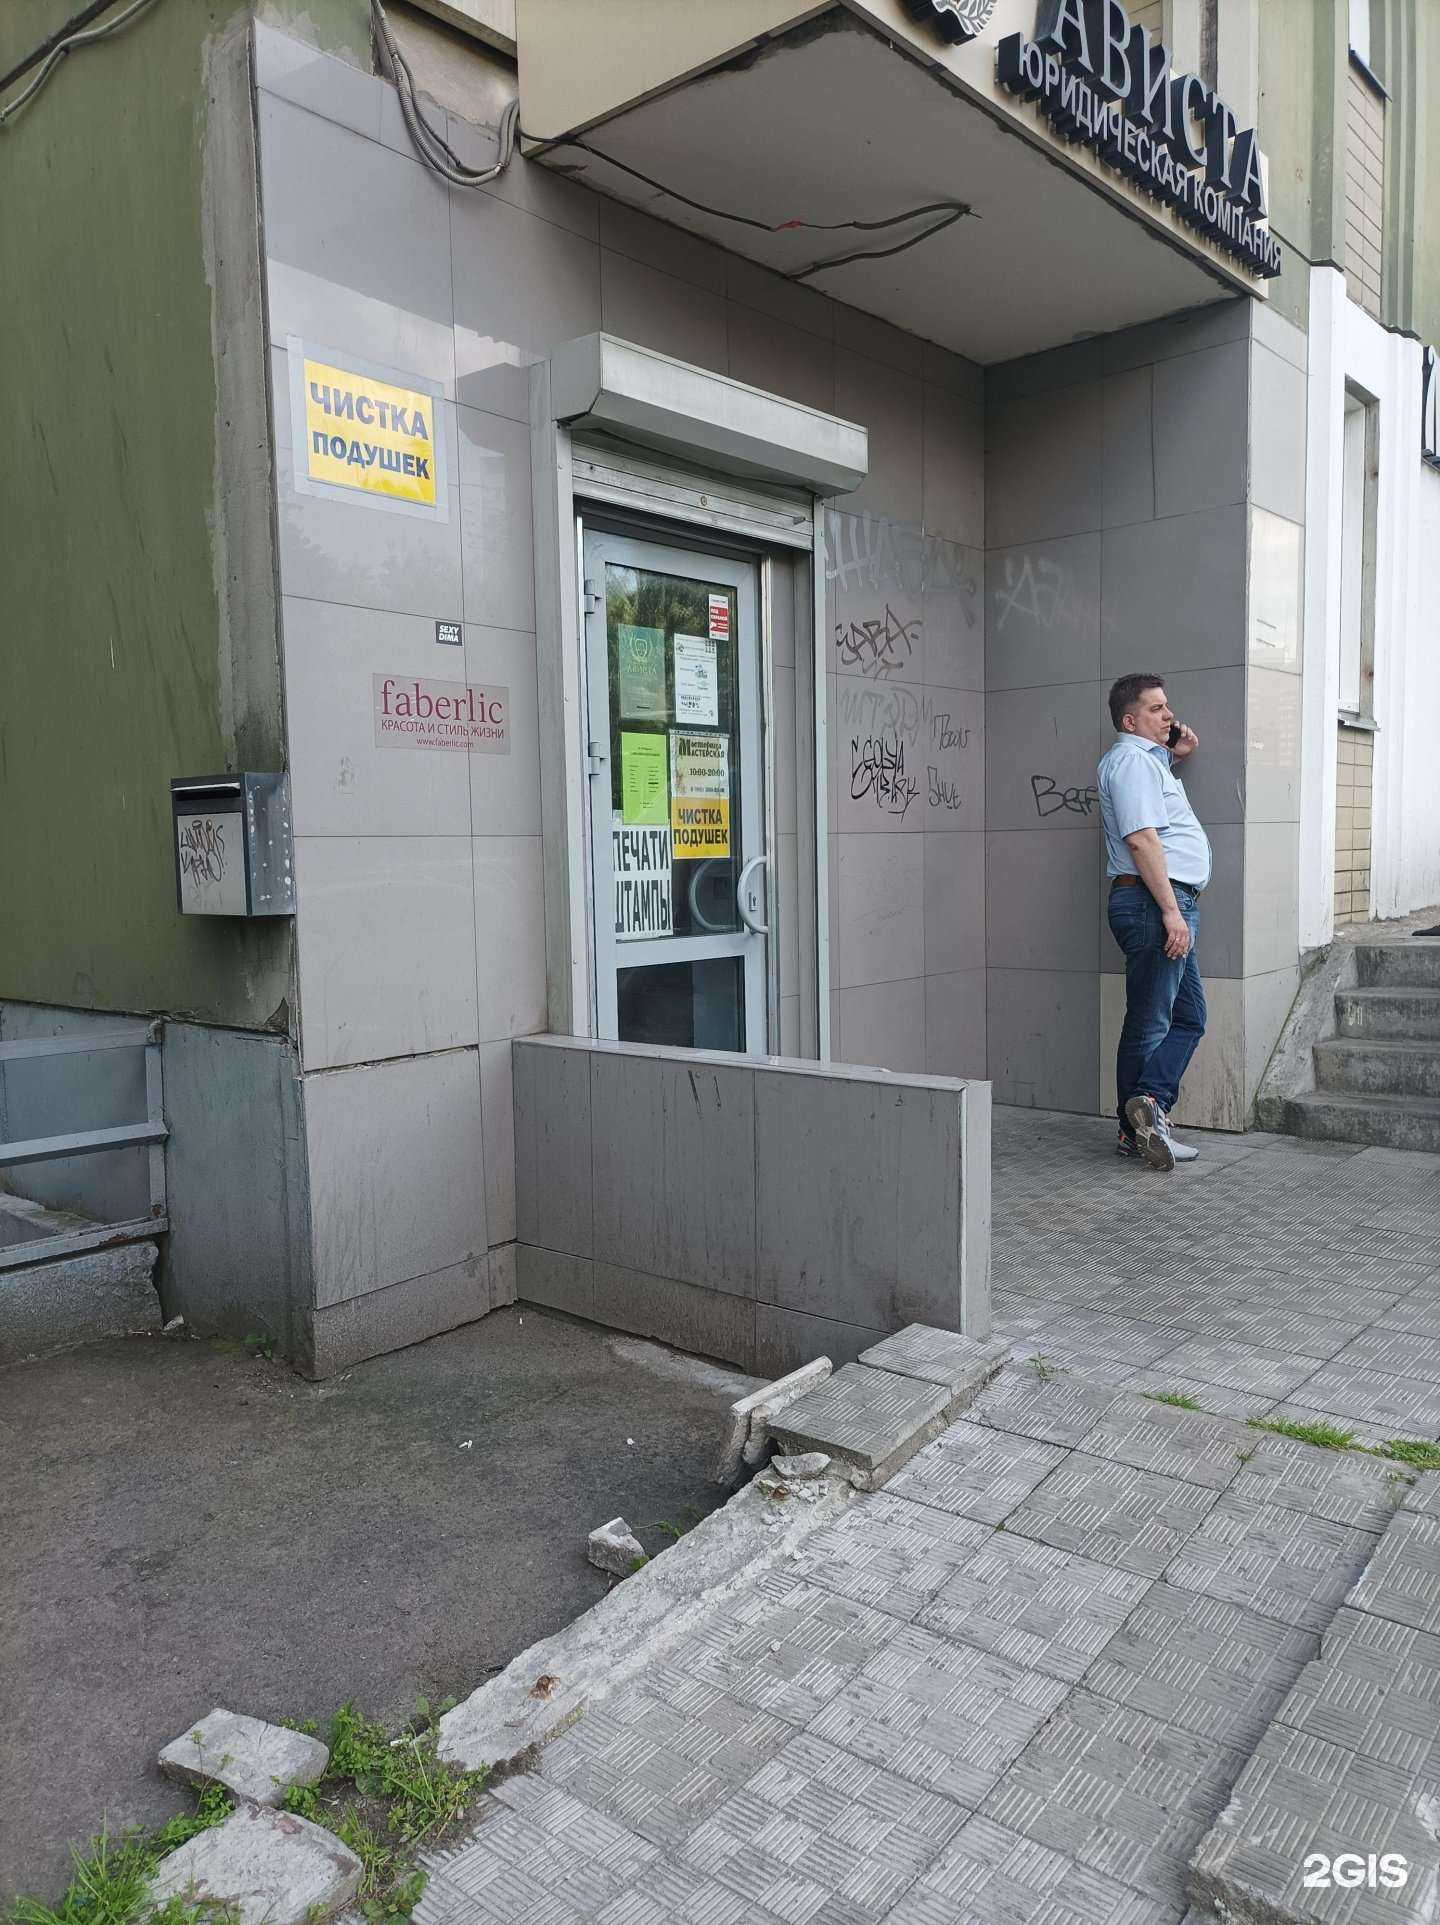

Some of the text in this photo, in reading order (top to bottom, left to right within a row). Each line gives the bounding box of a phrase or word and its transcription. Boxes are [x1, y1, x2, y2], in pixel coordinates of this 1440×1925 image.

[1051, 0, 1267, 217] АВИСТА
[1018, 32, 1282, 270] ЮРИДИЧЕСКАЯ КОМПАНИЯ
[310, 382, 428, 440] ЧИСТКА
[312, 431, 431, 480] ПОДУШЕК
[438, 633, 459, 643] DIMA
[439, 624, 459, 635] SEXY
[380, 679, 504, 724] faberlic
[381, 719, 505, 739] КРАСОТА И СТИЛЬ ЖИЗНИ
[673, 828, 729, 847] ПОДУШЕК
[678, 808, 723, 825] ЧИСТКА
[612, 830, 669, 872] ПЕЧАТИ
